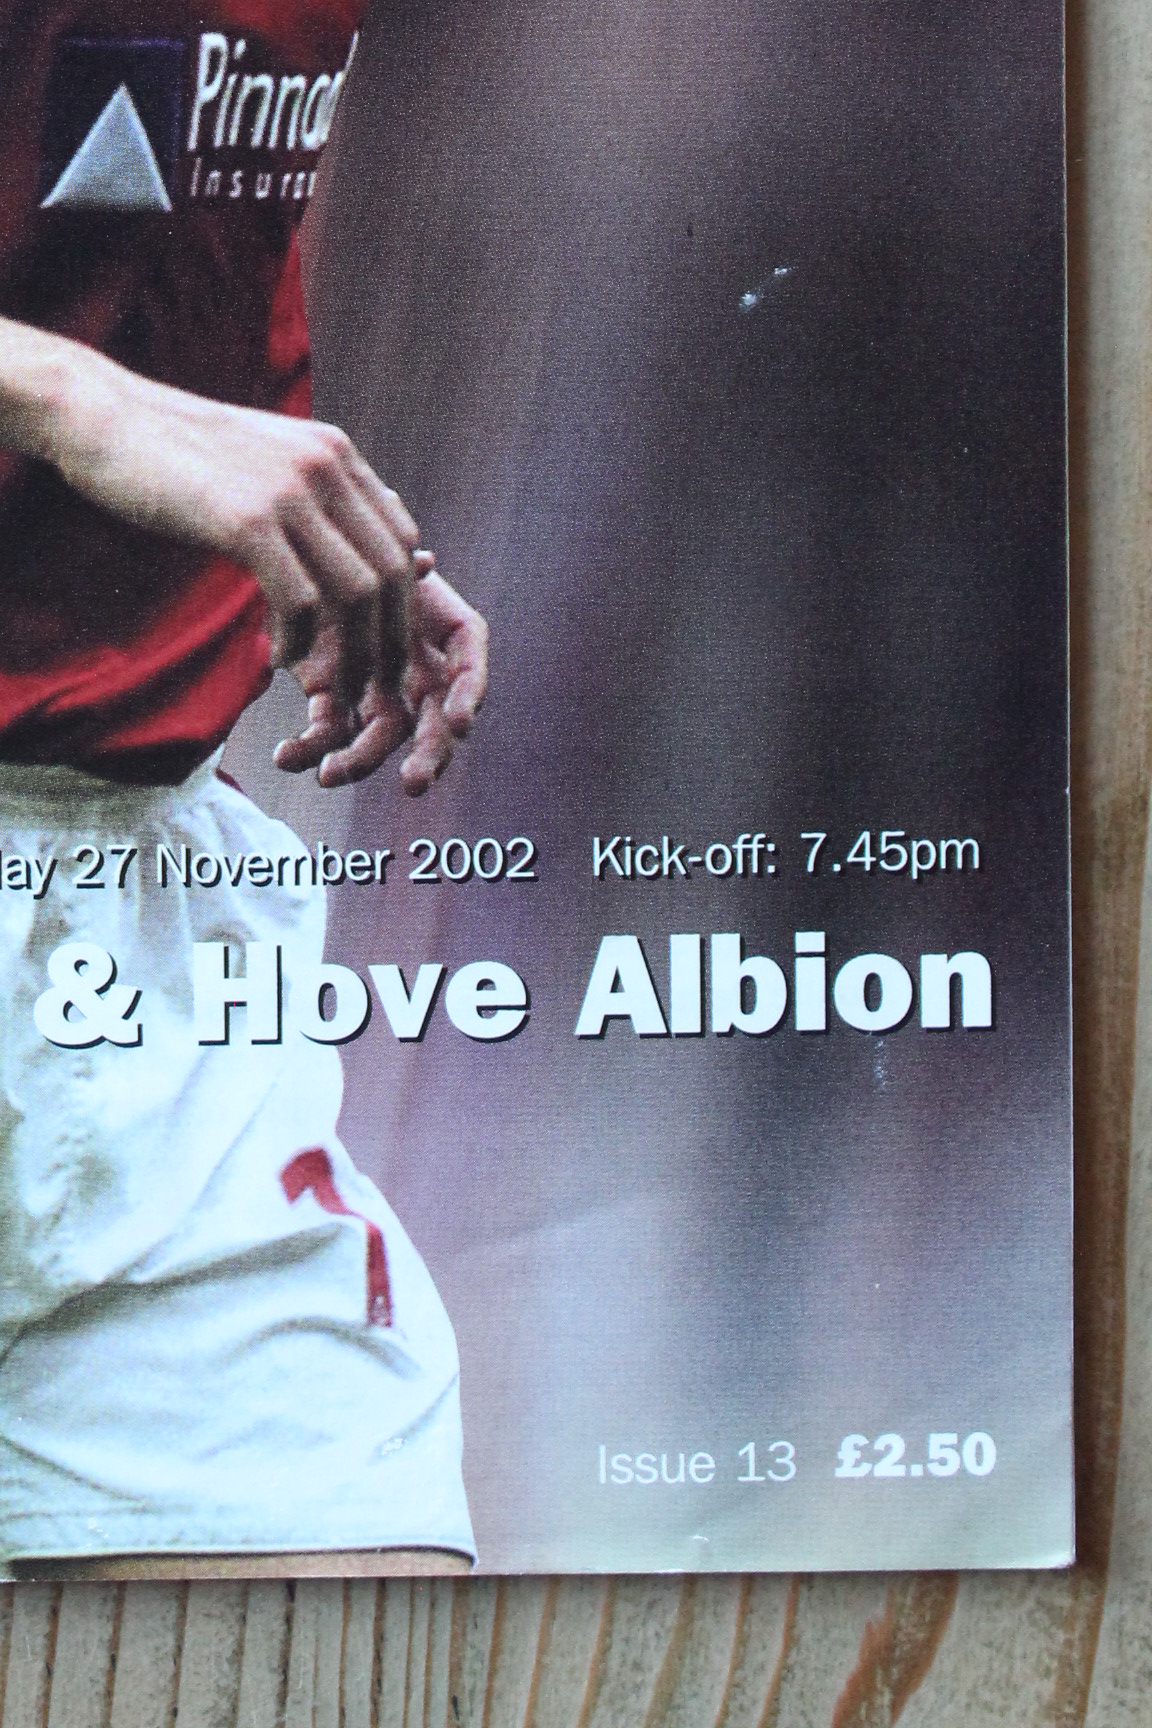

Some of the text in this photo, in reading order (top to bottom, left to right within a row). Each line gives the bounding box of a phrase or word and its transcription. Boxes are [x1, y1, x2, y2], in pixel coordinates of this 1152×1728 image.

[187, 31, 360, 151] Pinna
[72, 844, 137, 889] 27
[155, 842, 392, 888] November
[408, 838, 538, 882] 2002
[592, 834, 778, 878] Kick-off:
[800, 831, 982, 880] 7.45pm
[33, 941, 145, 1050] &
[193, 940, 532, 1045] Hove
[575, 930, 997, 1038] Albion
[598, 1432, 999, 1484] Issue 13 £2.50
